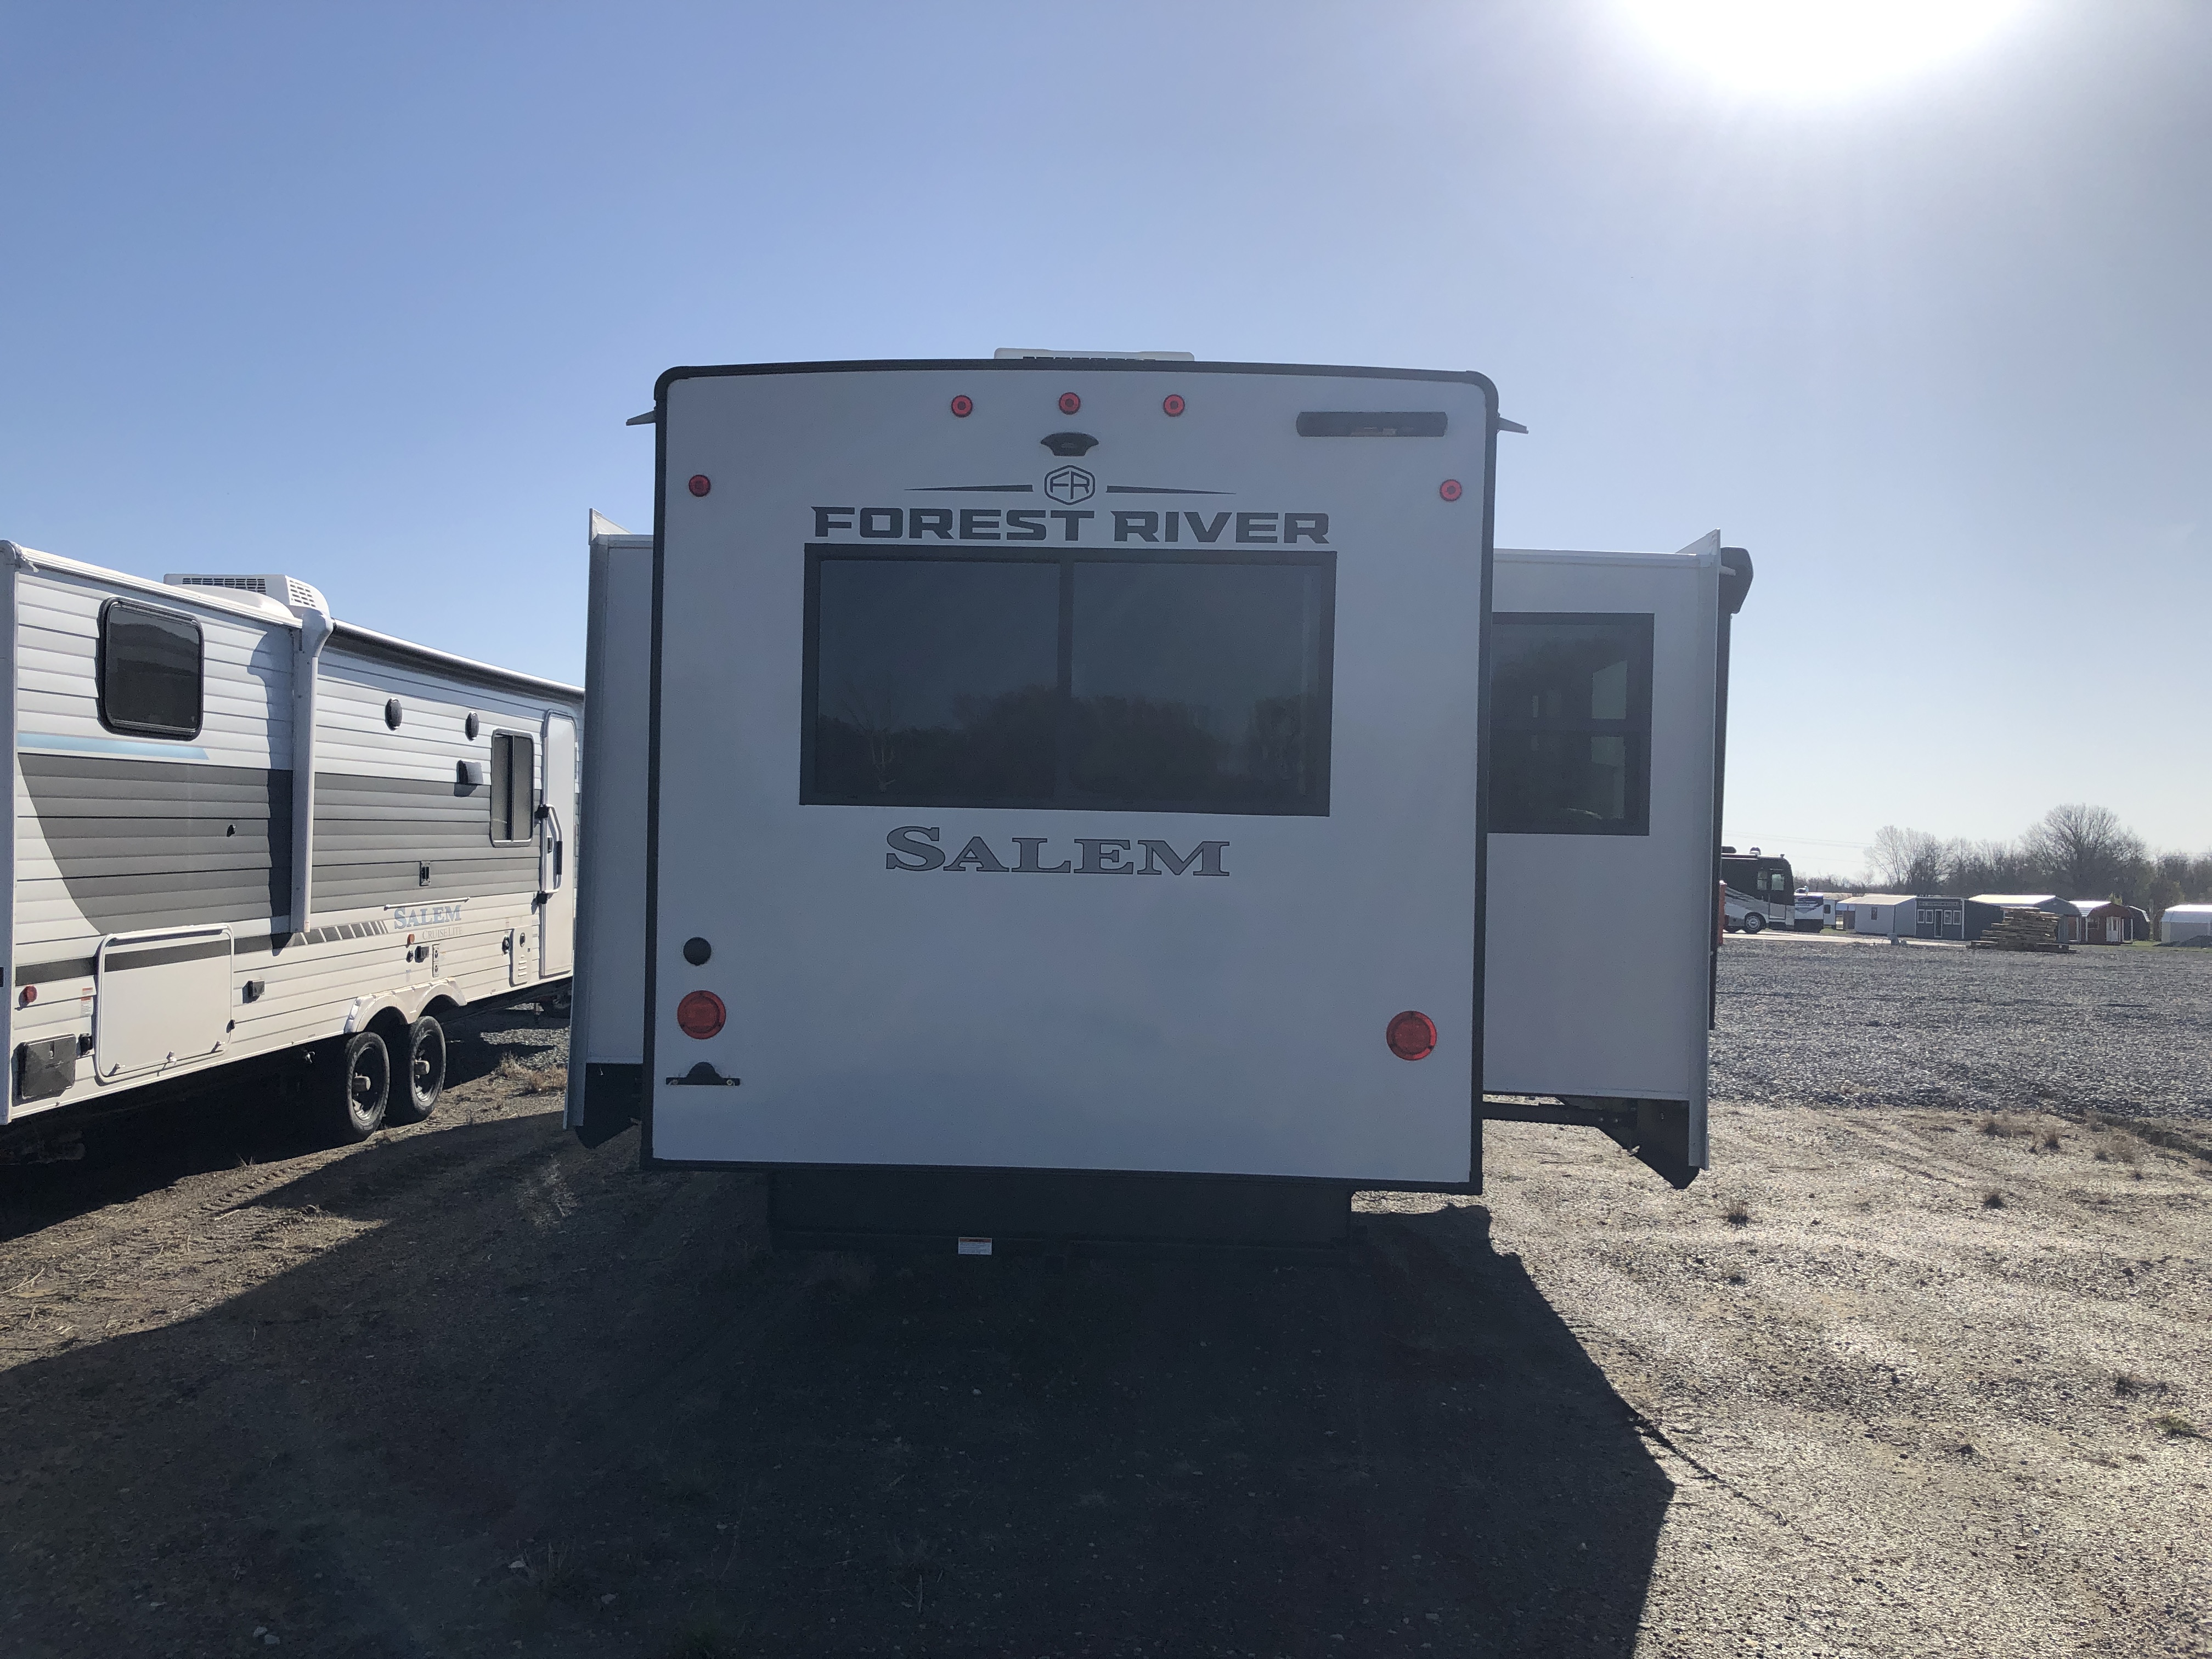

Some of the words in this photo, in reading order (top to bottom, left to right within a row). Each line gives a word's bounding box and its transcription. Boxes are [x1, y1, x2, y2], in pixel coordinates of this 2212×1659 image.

[1049, 470, 1090, 500] FR
[810, 506, 1095, 541] FOREST
[1110, 510, 1330, 544] RIVER
[885, 825, 1231, 877] SALEM
[394, 904, 462, 929] SALEM
